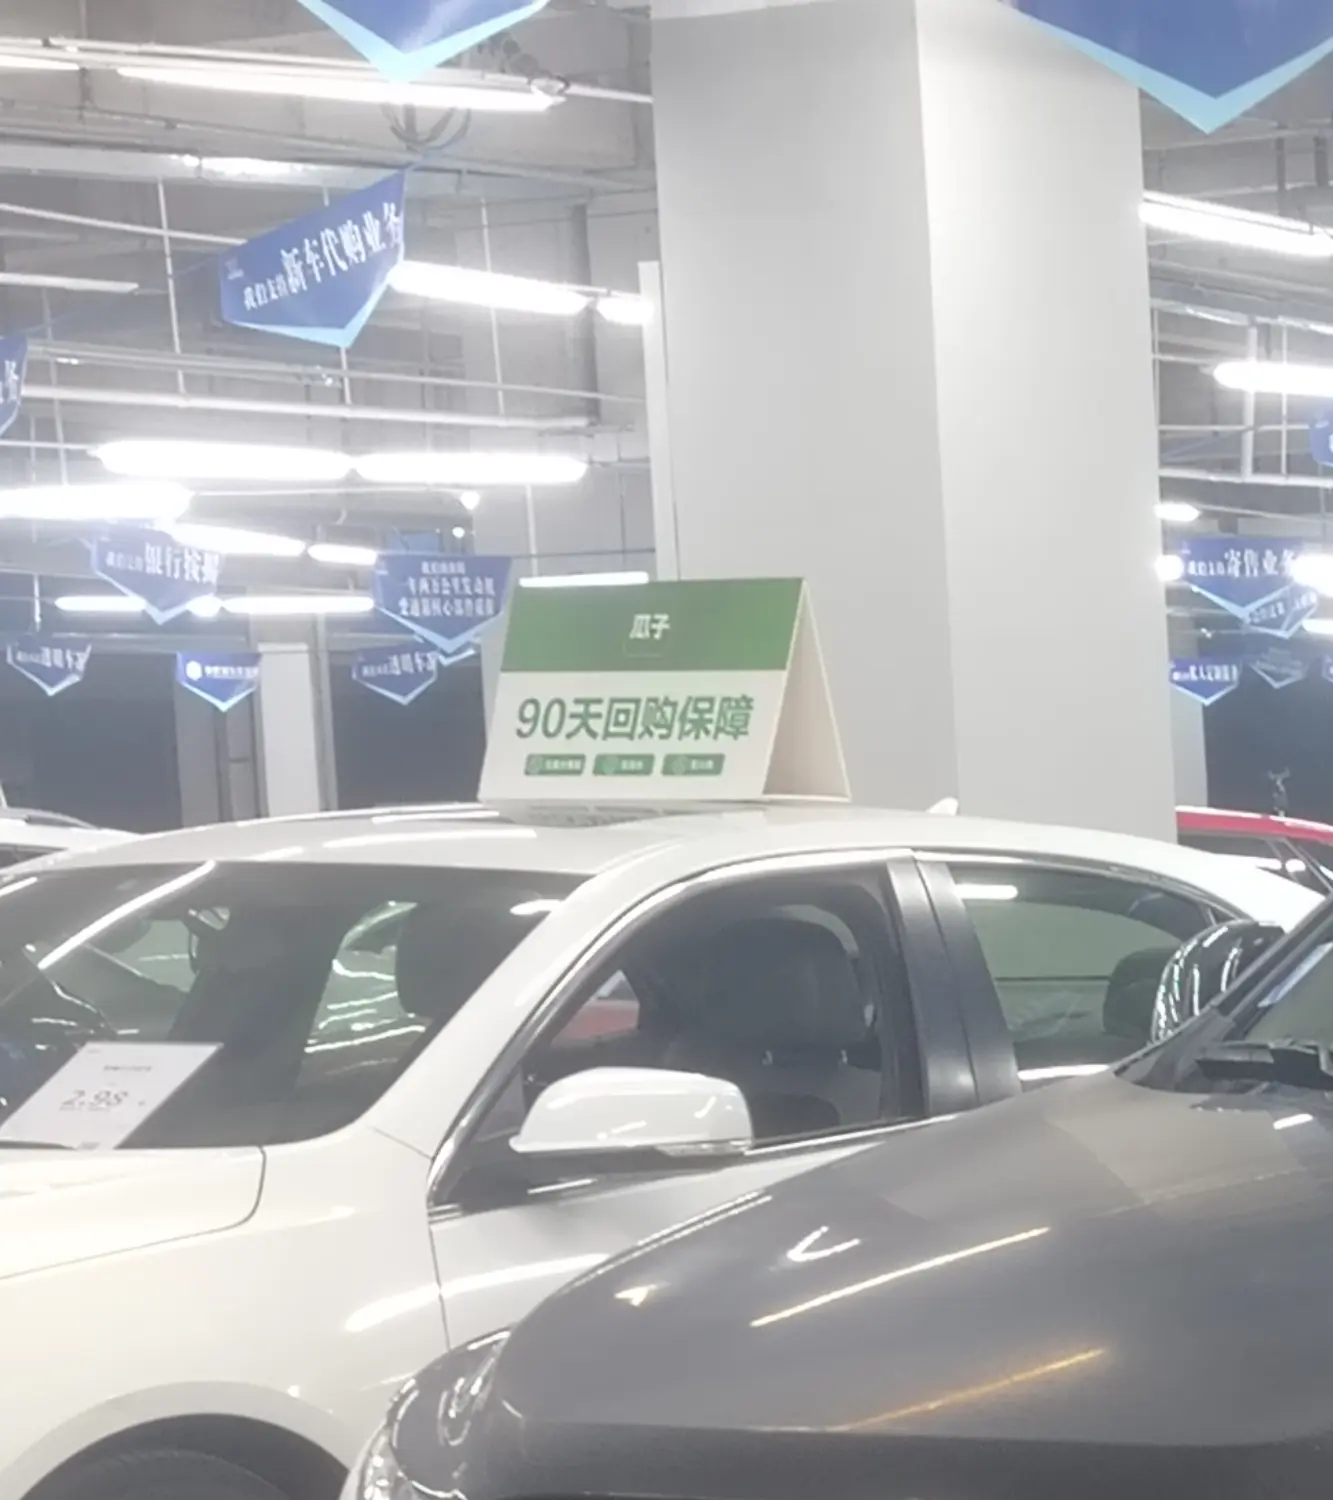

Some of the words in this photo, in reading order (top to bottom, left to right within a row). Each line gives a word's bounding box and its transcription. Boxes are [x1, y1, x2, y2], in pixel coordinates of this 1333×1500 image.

[243, 202, 402, 311] 我们支持新车代购业务
[629, 614, 670, 640] 瓜子
[515, 696, 754, 741] 90天回购保障
